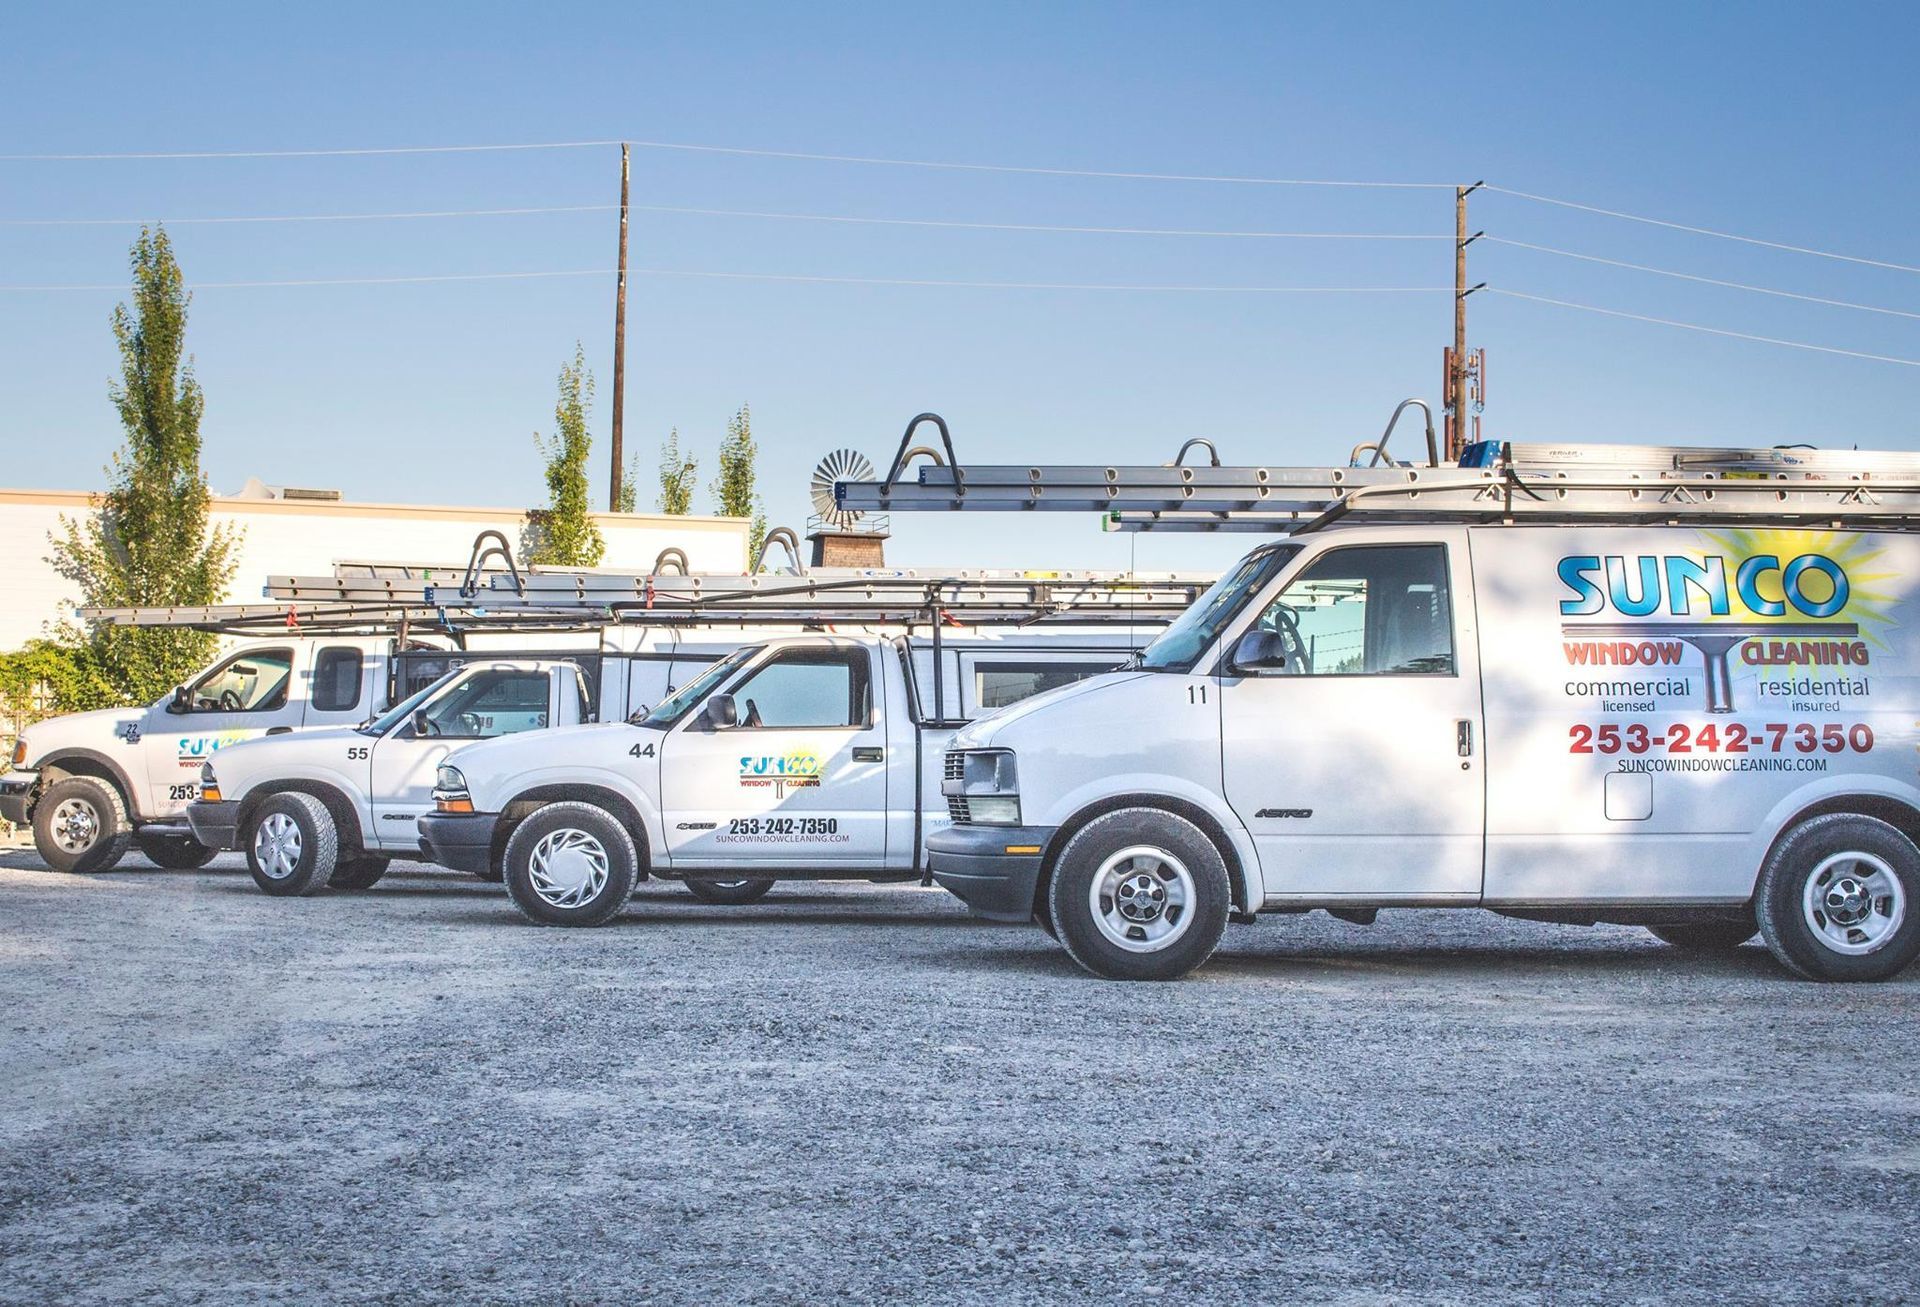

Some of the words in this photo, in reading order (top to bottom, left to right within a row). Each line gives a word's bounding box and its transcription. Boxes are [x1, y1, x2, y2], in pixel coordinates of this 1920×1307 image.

[1557, 554, 1850, 618] SUNCO
[1562, 641, 1683, 666] WINDOW
[1740, 641, 1869, 666] CLEANING
[1187, 684, 1207, 704] 11
[1565, 678, 1690, 697] commercial
[1759, 677, 1870, 697] residential
[1602, 700, 1655, 712] licensed
[1791, 700, 1840, 712] insured
[127, 723, 138, 734] 22
[1568, 723, 1875, 754] 253-242-7350
[347, 747, 369, 760] 55
[629, 743, 655, 758] 44
[178, 760, 206, 768] WINDO
[739, 756, 818, 774] SUNCO
[1617, 758, 1827, 773] SUNCOWINDOWCLEANING.COM
[786, 780, 821, 788] CLEANING
[729, 818, 838, 835] 253-242-7350
[715, 835, 850, 843] SUNCOWINDOWCLEANING.COM
